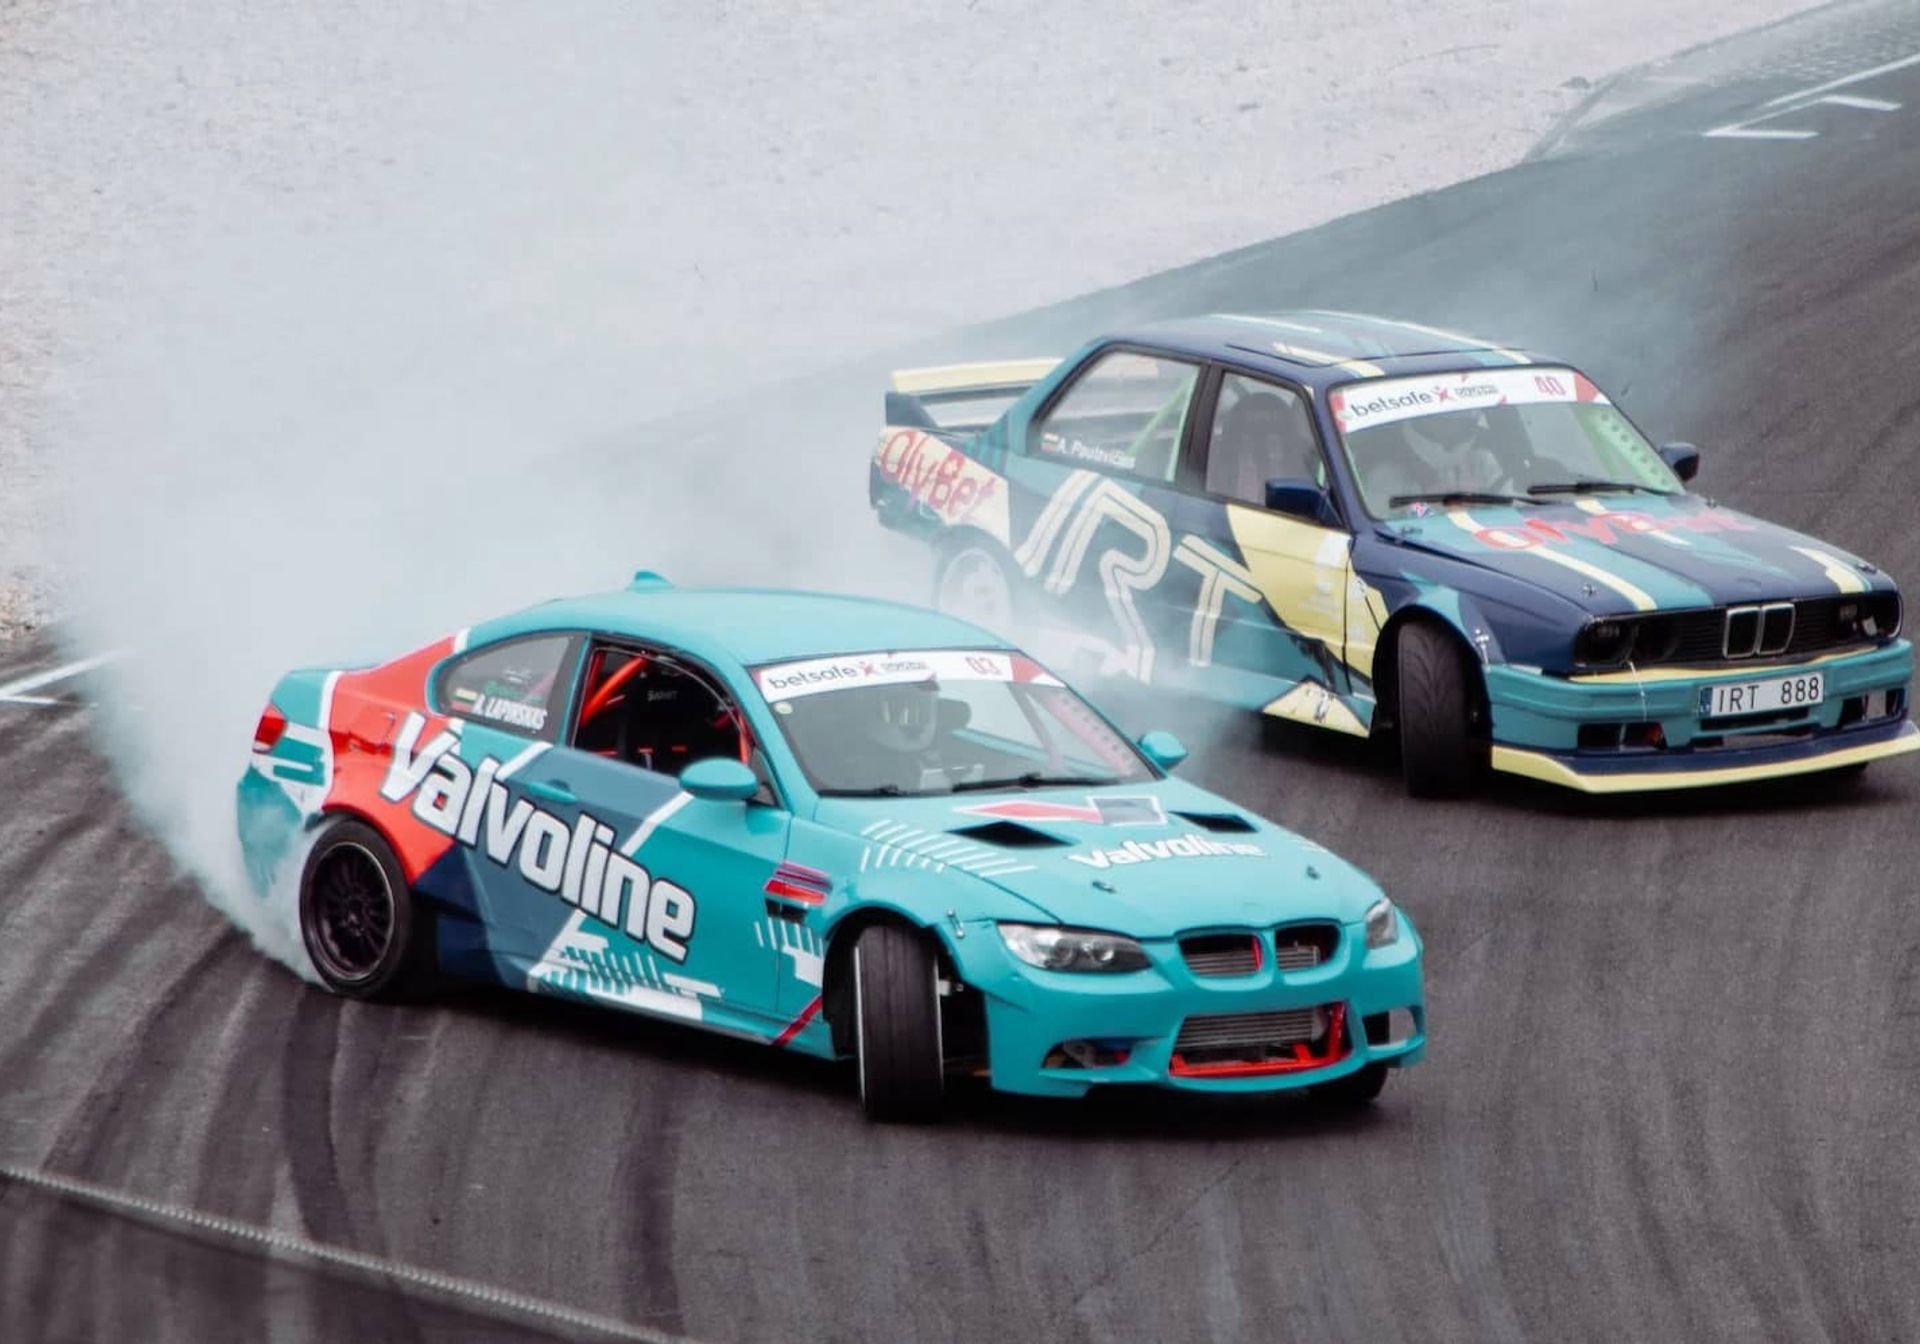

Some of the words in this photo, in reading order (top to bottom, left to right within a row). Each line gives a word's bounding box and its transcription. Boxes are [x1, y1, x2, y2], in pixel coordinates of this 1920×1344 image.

[1533, 375, 1567, 396] 40
[1350, 391, 1432, 417] betsafe
[1014, 469, 1264, 684] IRT
[769, 665, 858, 690] betsafe
[1718, 684, 1760, 713] IRT
[1780, 676, 1820, 705] 888
[379, 709, 697, 963] Valvoline
